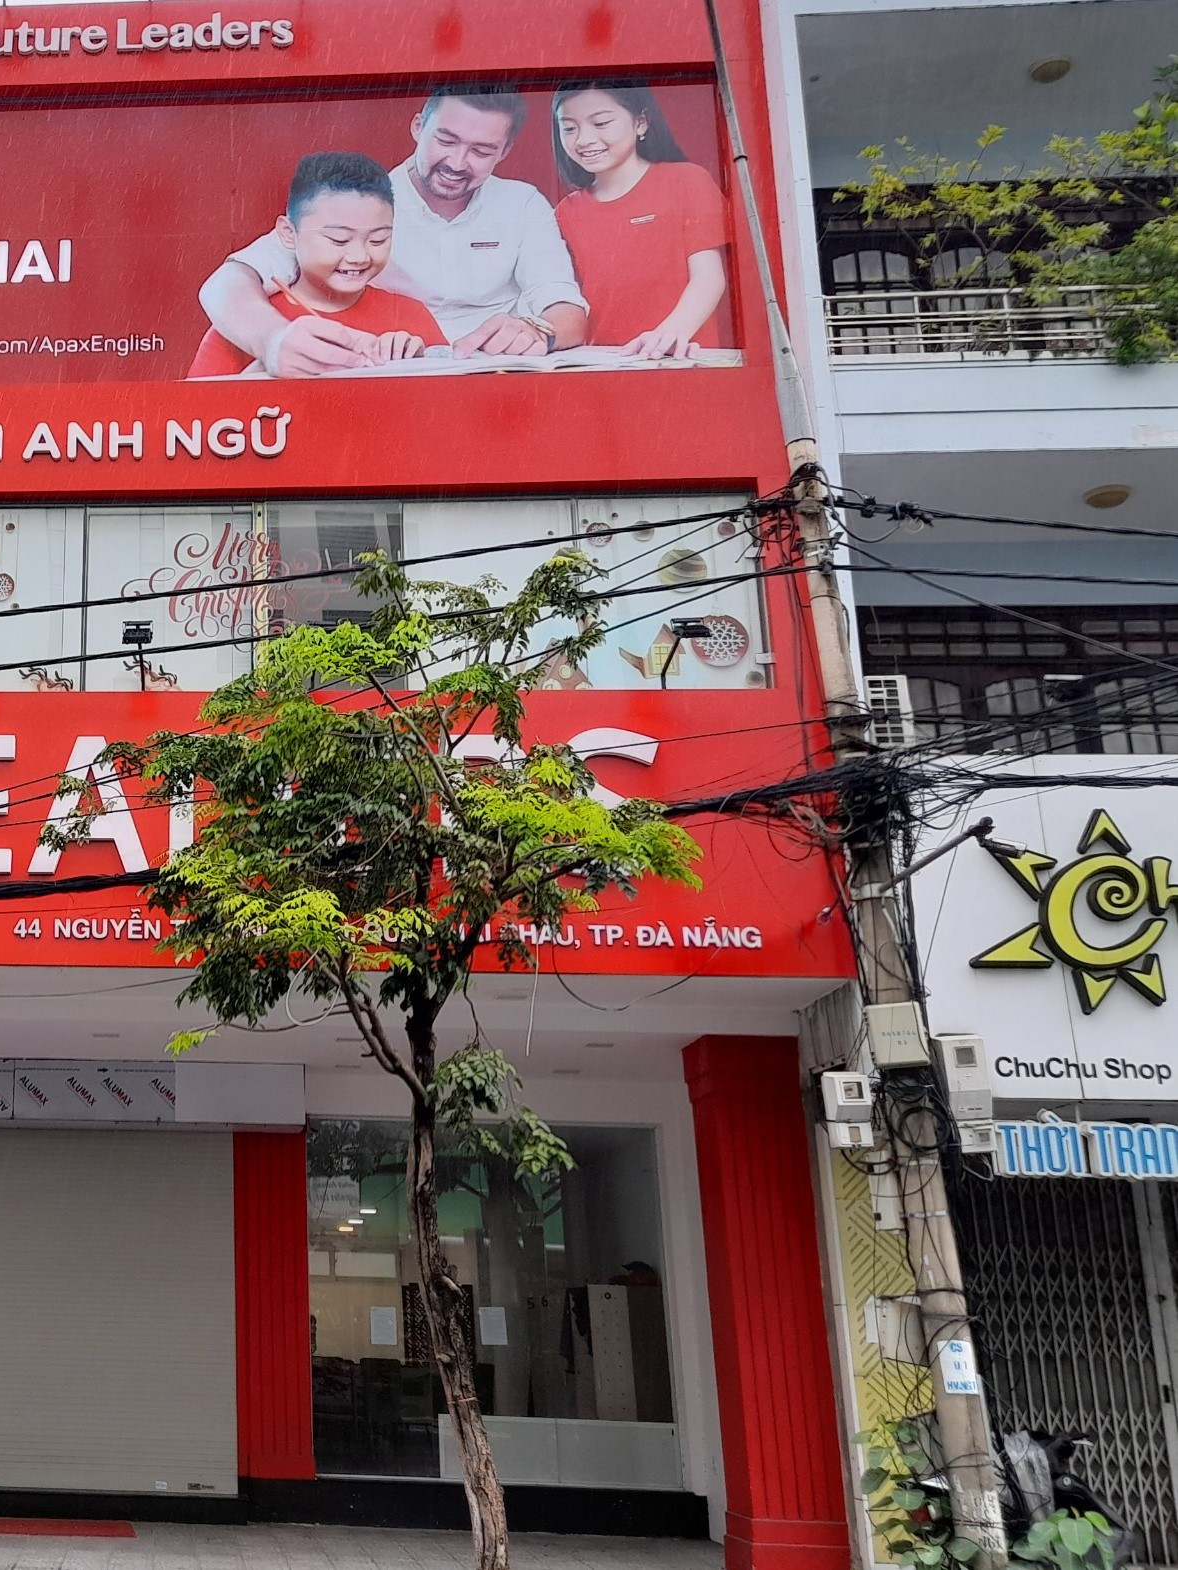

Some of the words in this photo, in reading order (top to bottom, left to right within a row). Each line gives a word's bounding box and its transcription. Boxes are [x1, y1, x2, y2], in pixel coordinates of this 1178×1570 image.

[116, 12, 294, 54] Leaders
[22, 420, 143, 462] ANH
[165, 405, 293, 460] NGỮ
[13, 918, 41, 939] 44
[54, 907, 161, 940] NGUYỄN
[588, 924, 629, 946] TP.
[636, 920, 674, 947] ĐÀ
[682, 915, 762, 948] NẴNG
[994, 1056, 1098, 1079] ChuChu
[1104, 1057, 1172, 1085] Shop
[18, 1075, 49, 1107] ALUMAX
[66, 1076, 97, 1107] ALUMAX
[102, 1077, 133, 1108] ALUMAX
[997, 1113, 1084, 1174] THỜI
